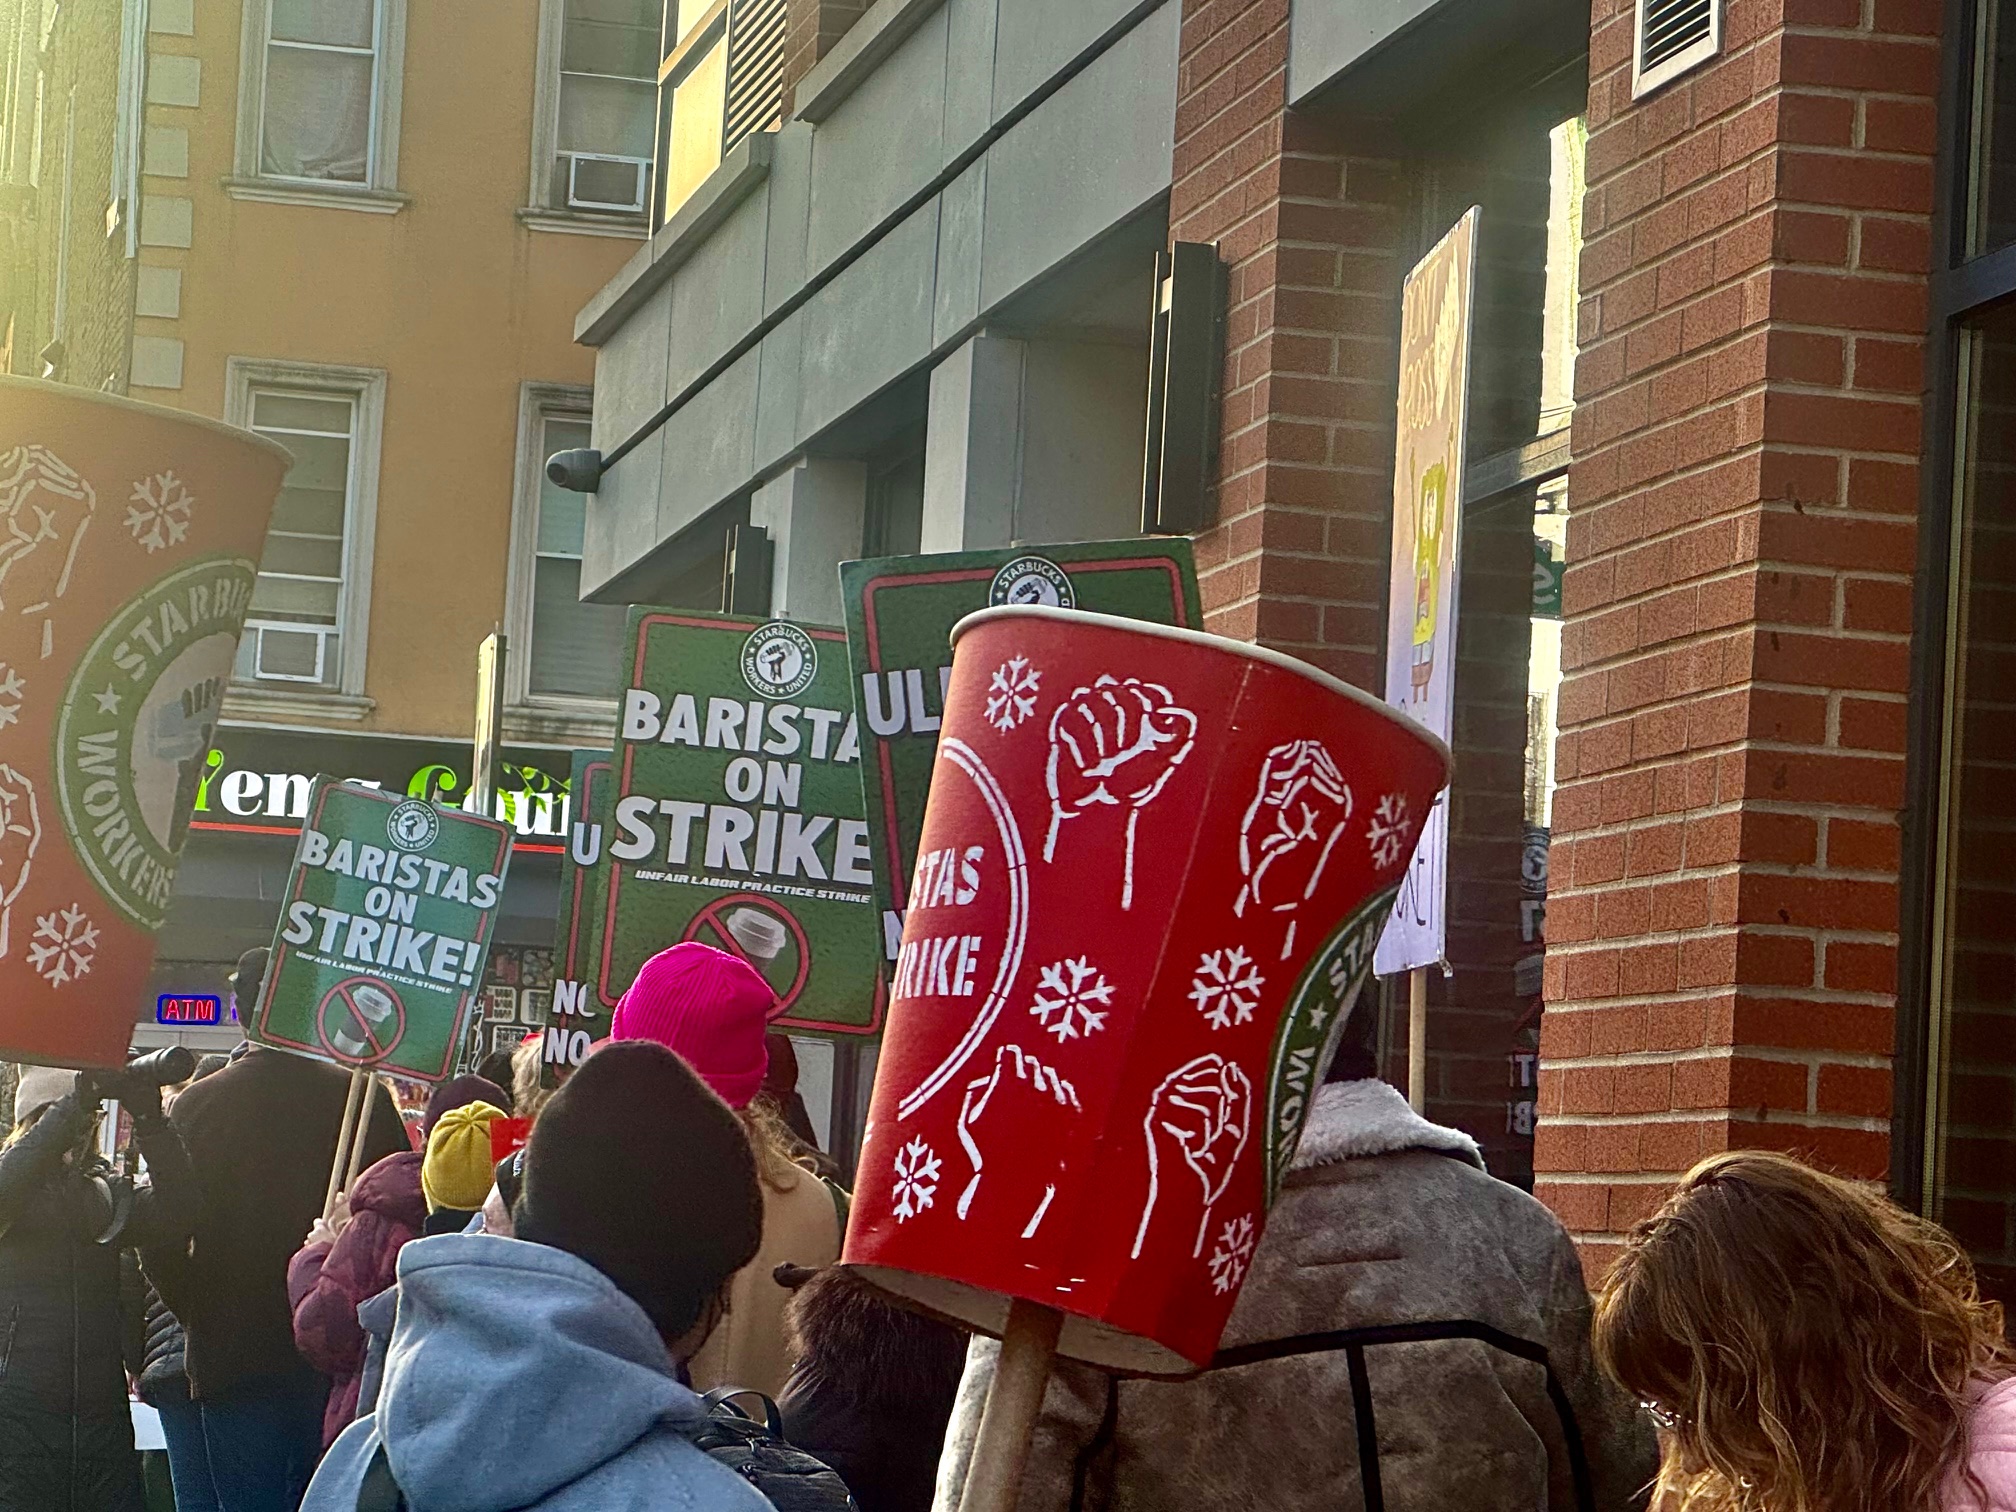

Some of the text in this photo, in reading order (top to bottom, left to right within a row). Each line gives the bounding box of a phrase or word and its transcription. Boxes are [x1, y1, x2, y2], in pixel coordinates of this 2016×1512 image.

[998, 561, 1062, 588] STARBUCKS
[754, 625, 810, 651] STARBUCKS
[745, 657, 776, 694] WORKERS
[786, 662, 813, 694] UNITED
[862, 666, 952, 736] UL
[622, 689, 861, 763] BARISTA
[725, 757, 801, 807] ON
[301, 830, 499, 909] BARISTAS
[635, 869, 871, 904] UNFAIR LABOR PRACTICE STRIKE
[364, 887, 417, 924] ON
[281, 901, 480, 987] STRIKE!
[366, 968, 415, 985] PRACTICE
[415, 979, 453, 994] STRIKE
[896, 935, 982, 1000] RIKE
[165, 999, 214, 1020] ATM
